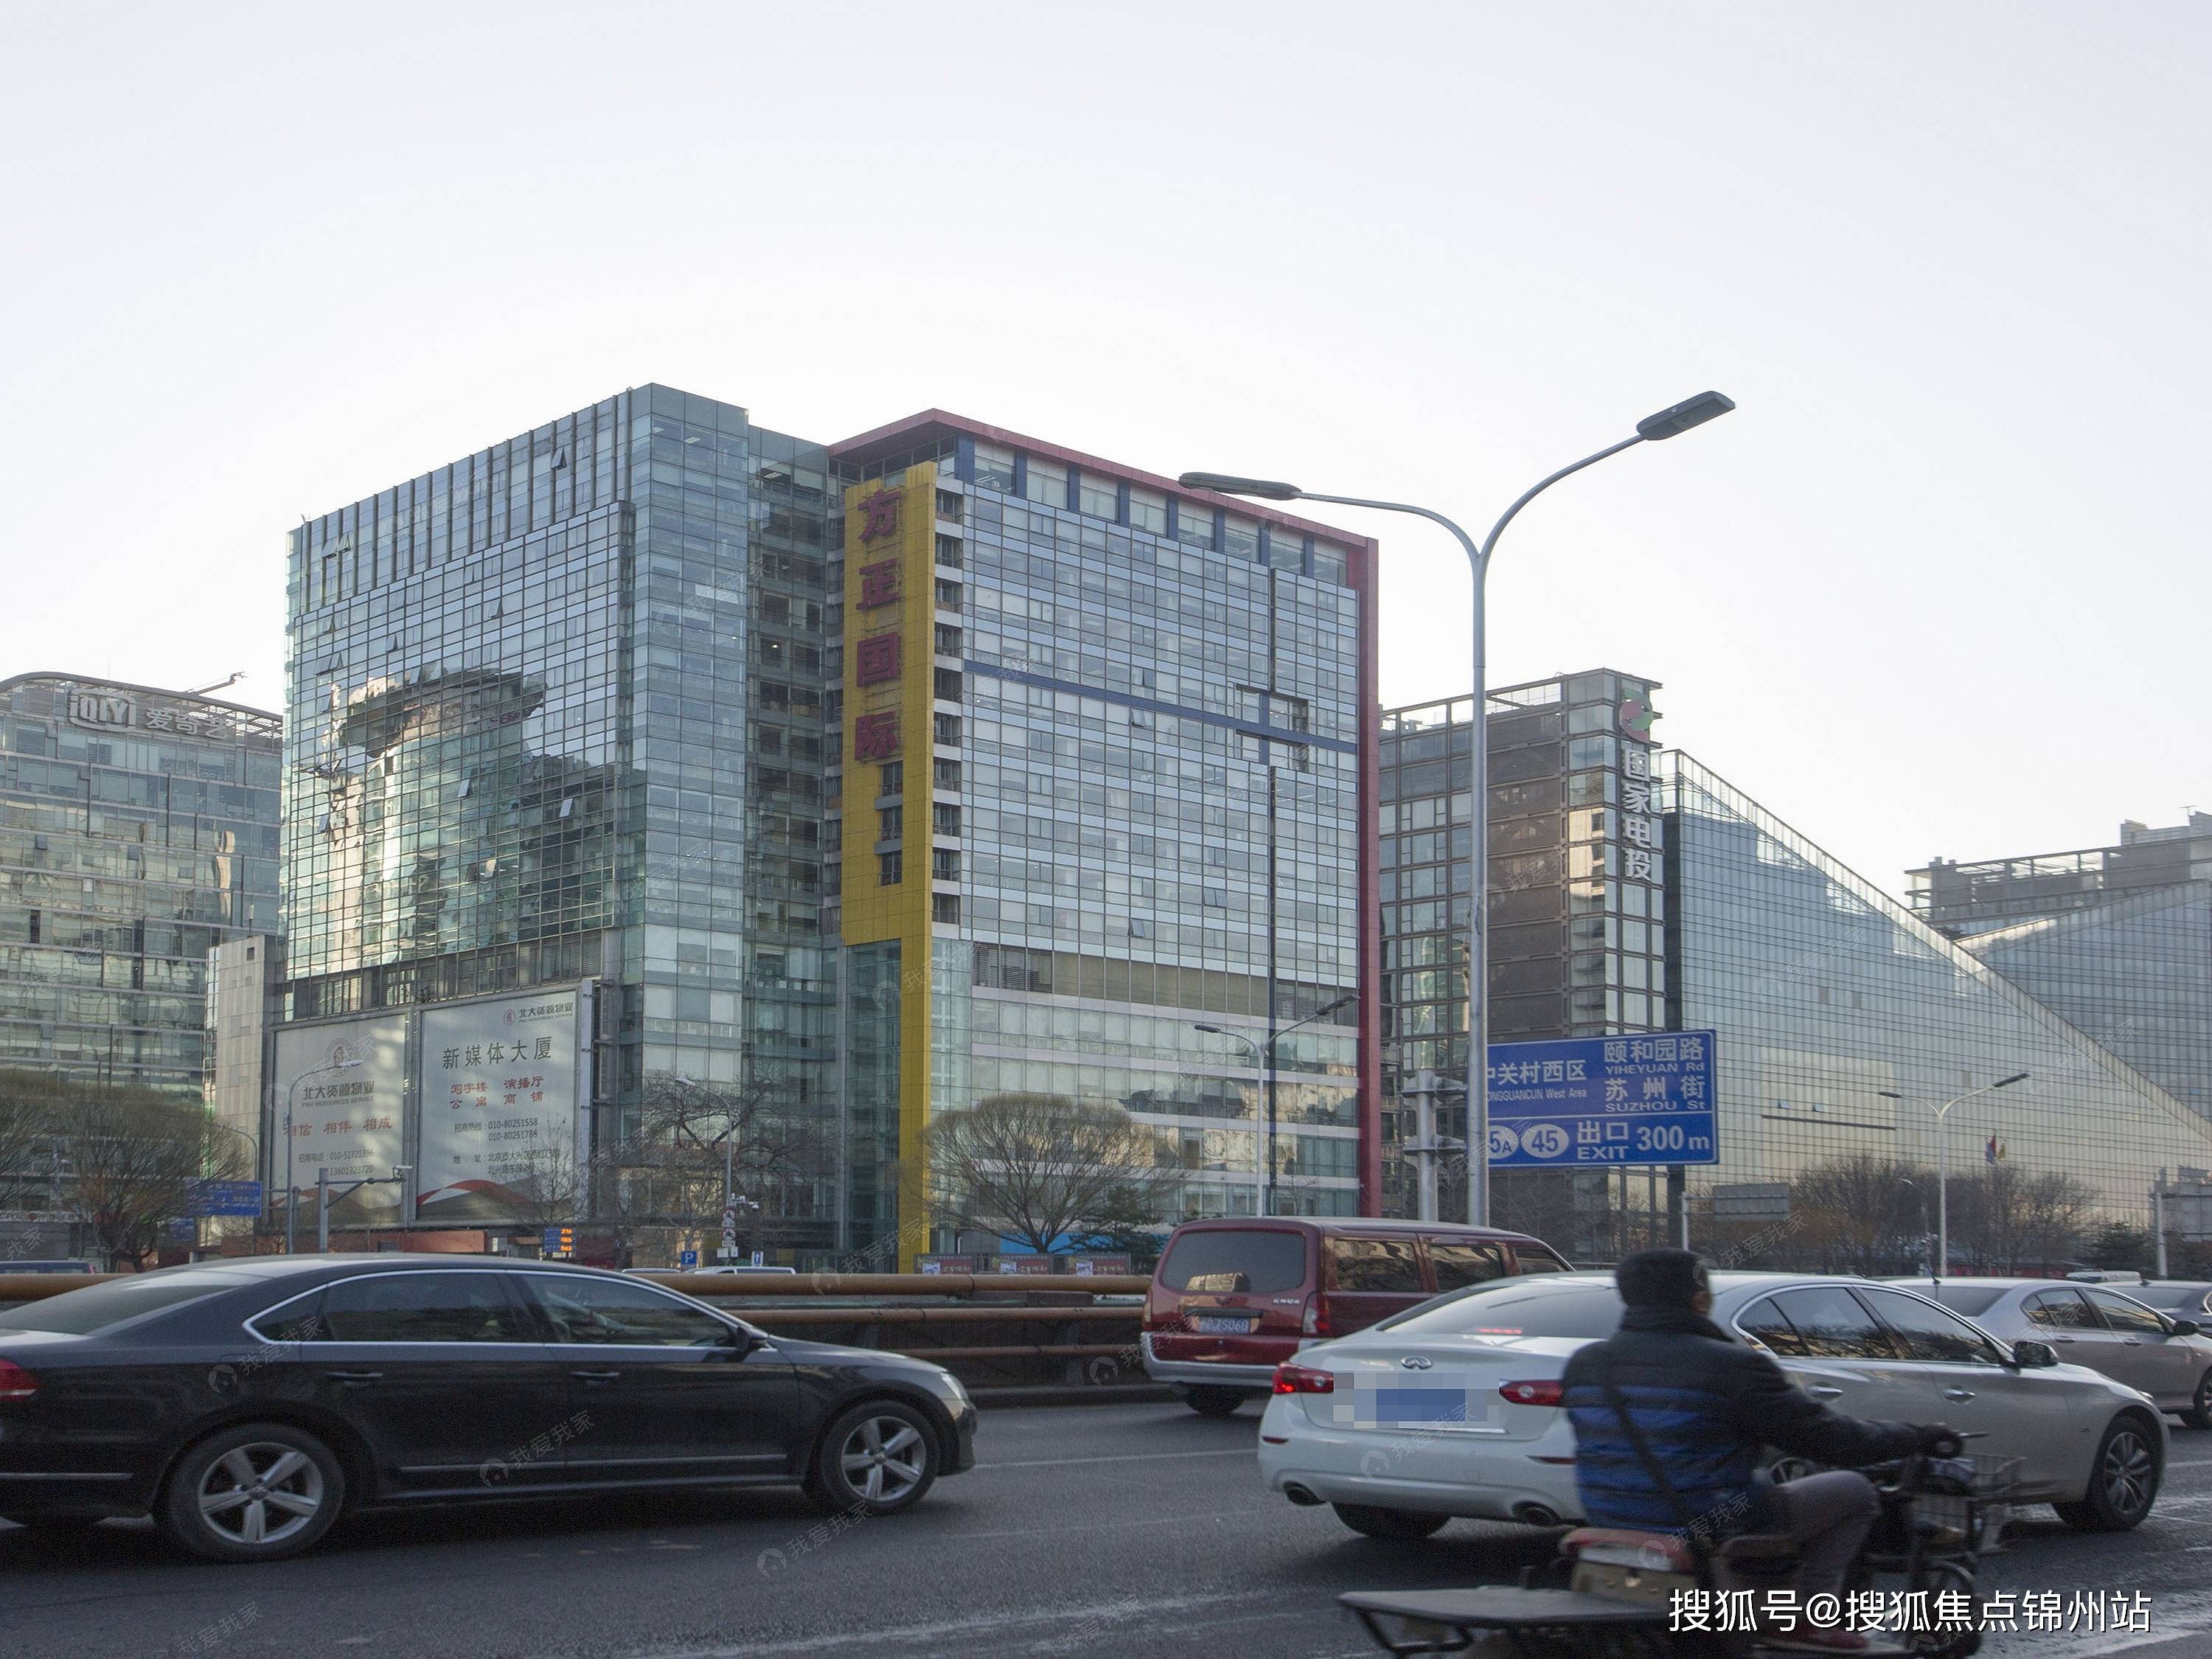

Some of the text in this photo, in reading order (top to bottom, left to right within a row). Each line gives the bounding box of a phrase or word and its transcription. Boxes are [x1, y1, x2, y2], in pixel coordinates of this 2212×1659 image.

[855, 488, 903, 762] 方正国际
[146, 708, 227, 739] 爱奇艺
[1624, 748, 1651, 881] 国家电投
[442, 1036, 552, 1069] 新媒体大厦
[1604, 1037, 1704, 1062] 颐和园路
[1604, 1062, 1704, 1074] YIHEYUAN Rd
[303, 1080, 375, 1099] 北大资源物业
[451, 1076, 543, 1095] 写字楼 演播厅
[1545, 1088, 1566, 1099] West
[1568, 1088, 1587, 1097] Area
[1605, 1075, 1705, 1102] 苏州街
[1605, 1101, 1705, 1113] SUZHOU St
[323, 1120, 352, 1135] 相伴
[1577, 1119, 1629, 1144] 出口
[1637, 1126, 1710, 1151] 300 m
[1531, 1130, 1558, 1152] 45
[1577, 1146, 1629, 1161] EXIT
